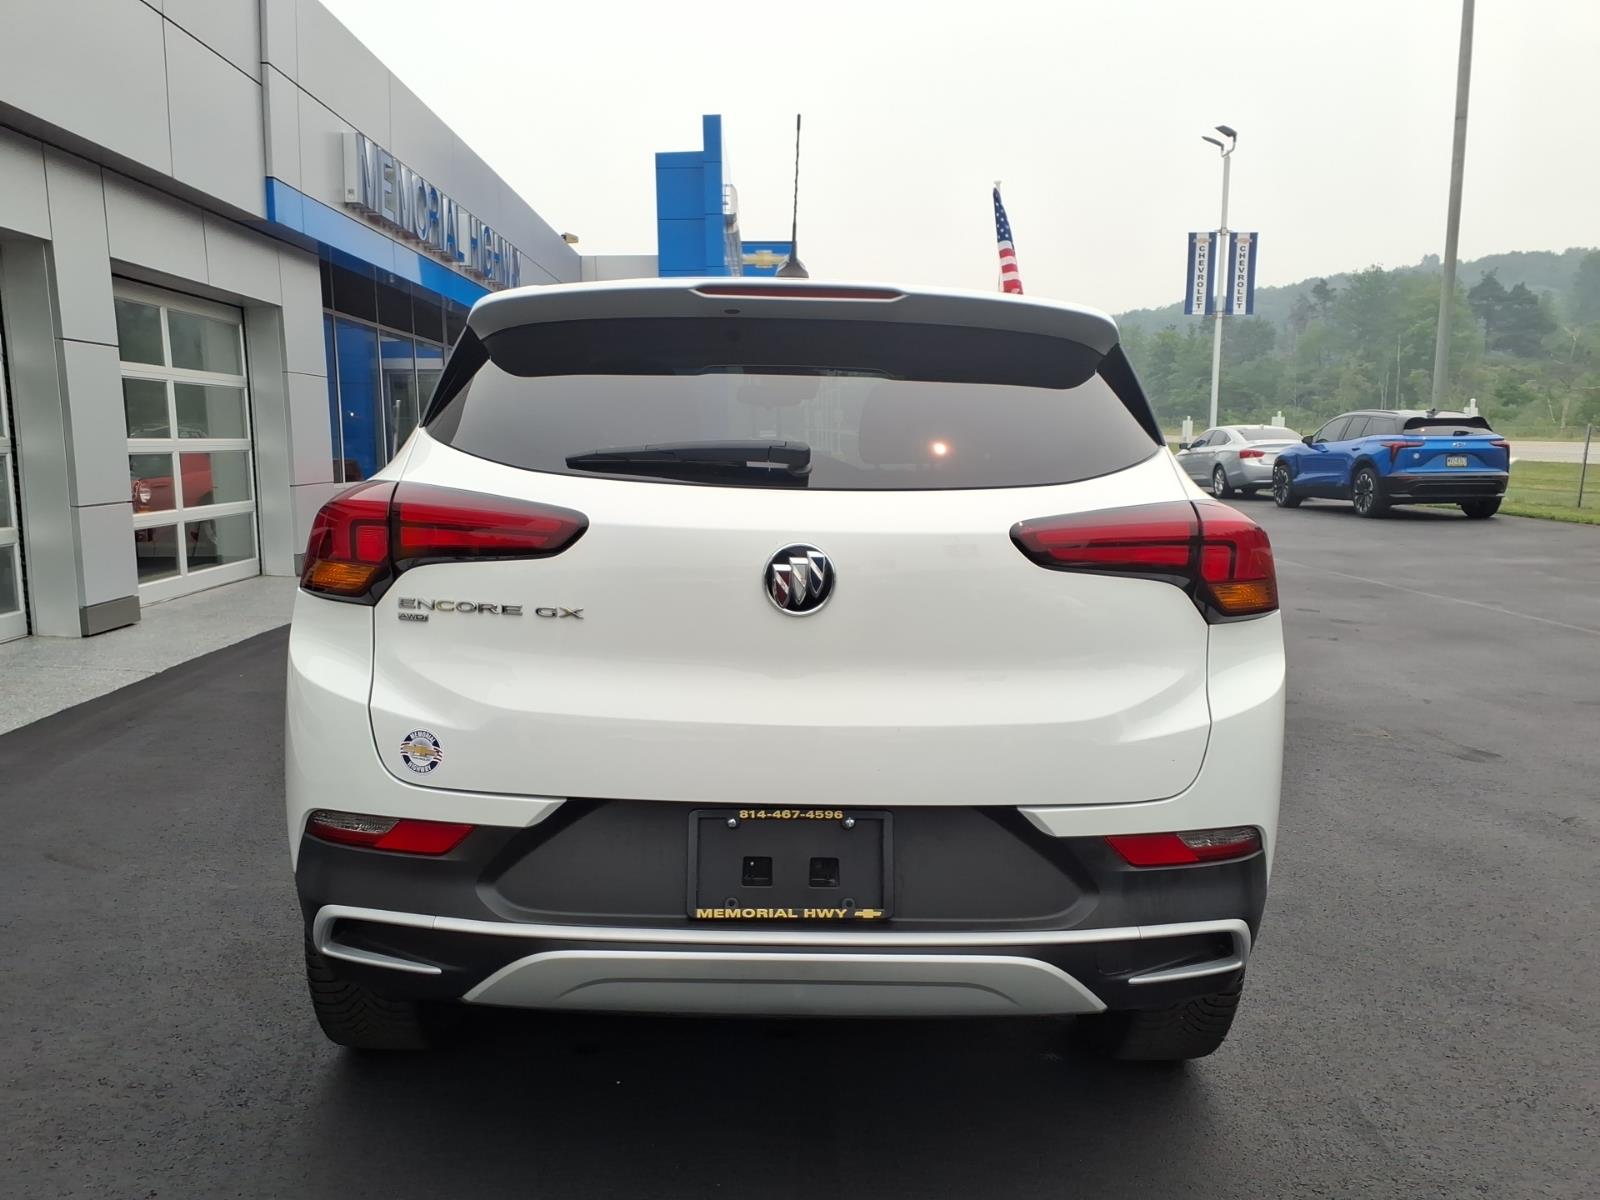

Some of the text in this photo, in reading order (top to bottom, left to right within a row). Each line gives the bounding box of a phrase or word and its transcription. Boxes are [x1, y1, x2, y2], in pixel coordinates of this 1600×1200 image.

[343, 132, 467, 263] MEMORIAL
[1196, 245, 1206, 309] CHEVROLET
[1236, 245, 1246, 309] CHEVROLET
[398, 598, 584, 620] ENCORE GX
[399, 612, 429, 622] AWD
[739, 809, 844, 820] 814-467-4596
[696, 908, 848, 919] MEMORIAL HWY
